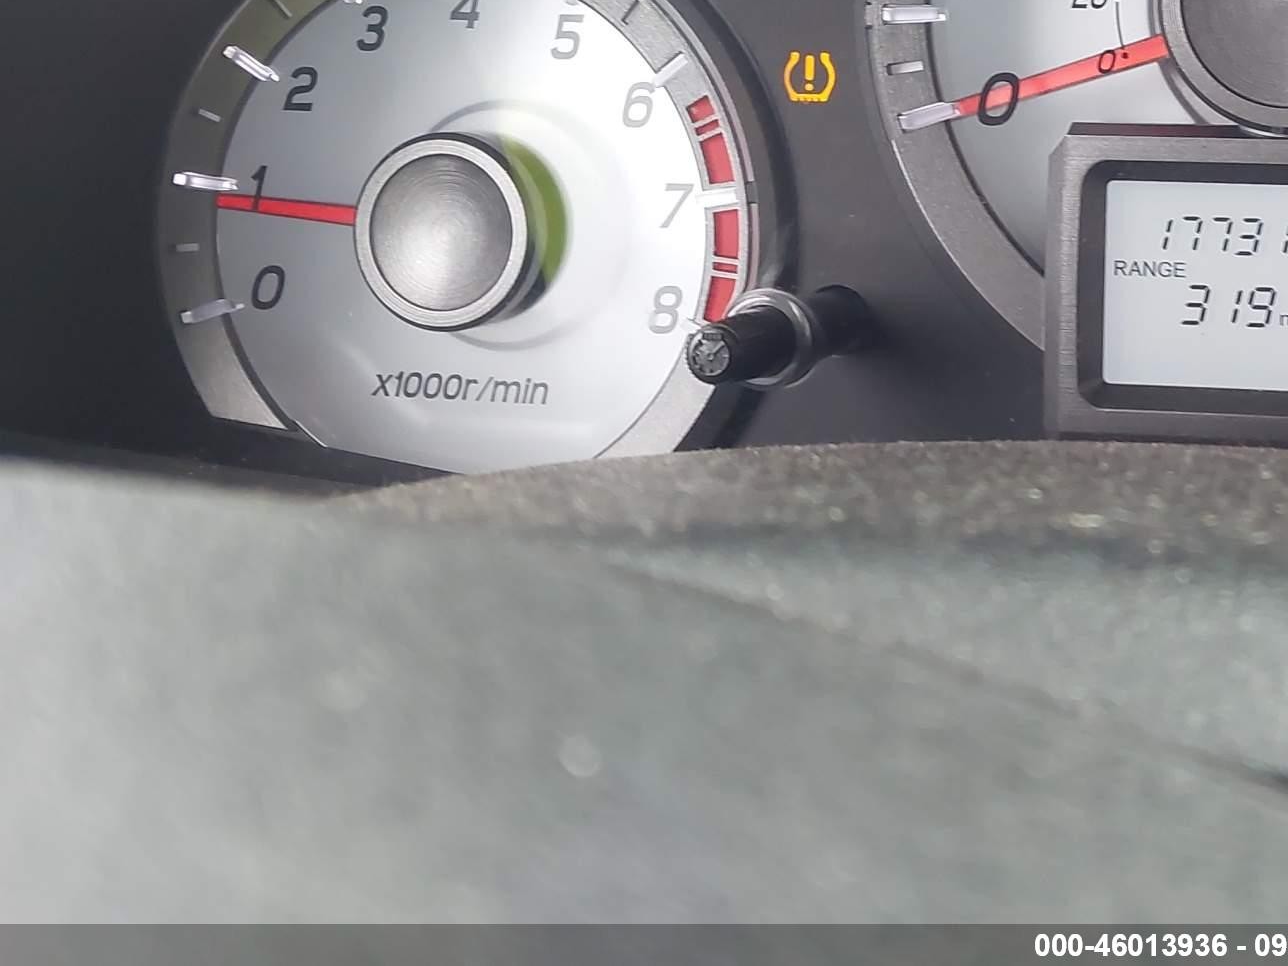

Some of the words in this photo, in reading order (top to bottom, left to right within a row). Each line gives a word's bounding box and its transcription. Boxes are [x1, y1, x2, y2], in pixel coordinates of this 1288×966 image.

[356, 6, 388, 52] 3
[550, 14, 585, 60] 5
[1098, 49, 1116, 74] 0
[284, 67, 318, 112] 2
[622, 82, 654, 128] 6
[978, 72, 1020, 126] 0
[250, 166, 269, 211] 1
[658, 184, 694, 228] 7
[252, 265, 285, 310] 0
[1113, 260, 1187, 278] RANGE
[649, 286, 682, 333] 8
[1181, 284, 1276, 328] 319
[372, 372, 549, 405] x1000r/min
